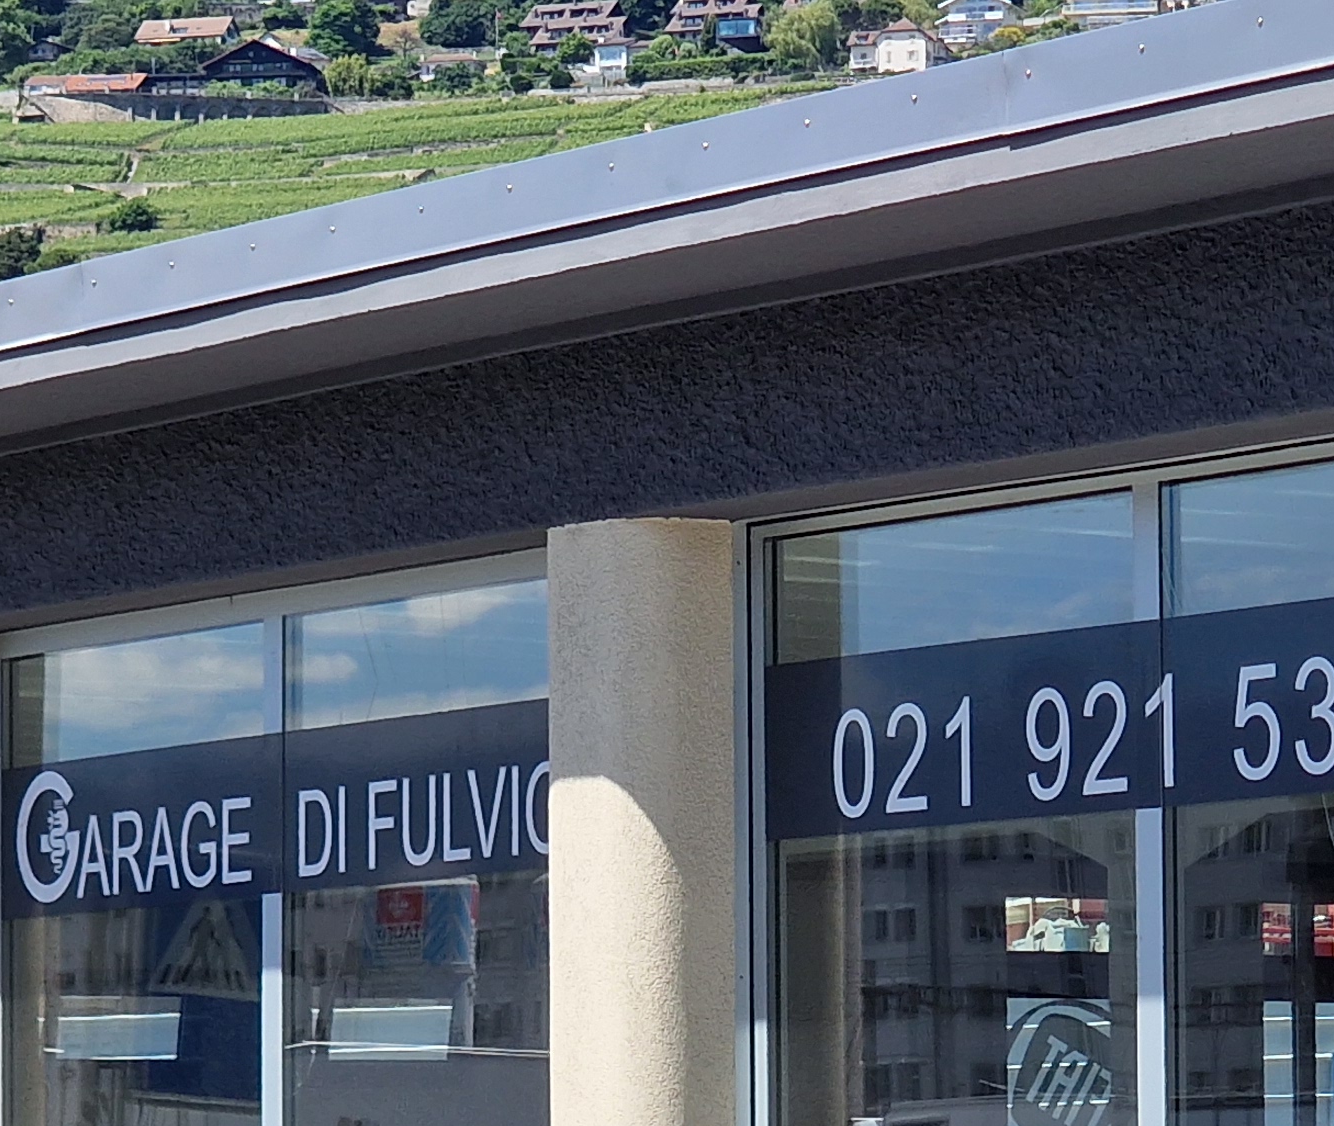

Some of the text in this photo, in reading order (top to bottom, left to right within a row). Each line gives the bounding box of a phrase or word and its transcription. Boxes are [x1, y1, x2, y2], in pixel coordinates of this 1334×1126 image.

[832, 695, 973, 819] 021
[1025, 672, 1175, 802] 921
[297, 785, 348, 879] DI
